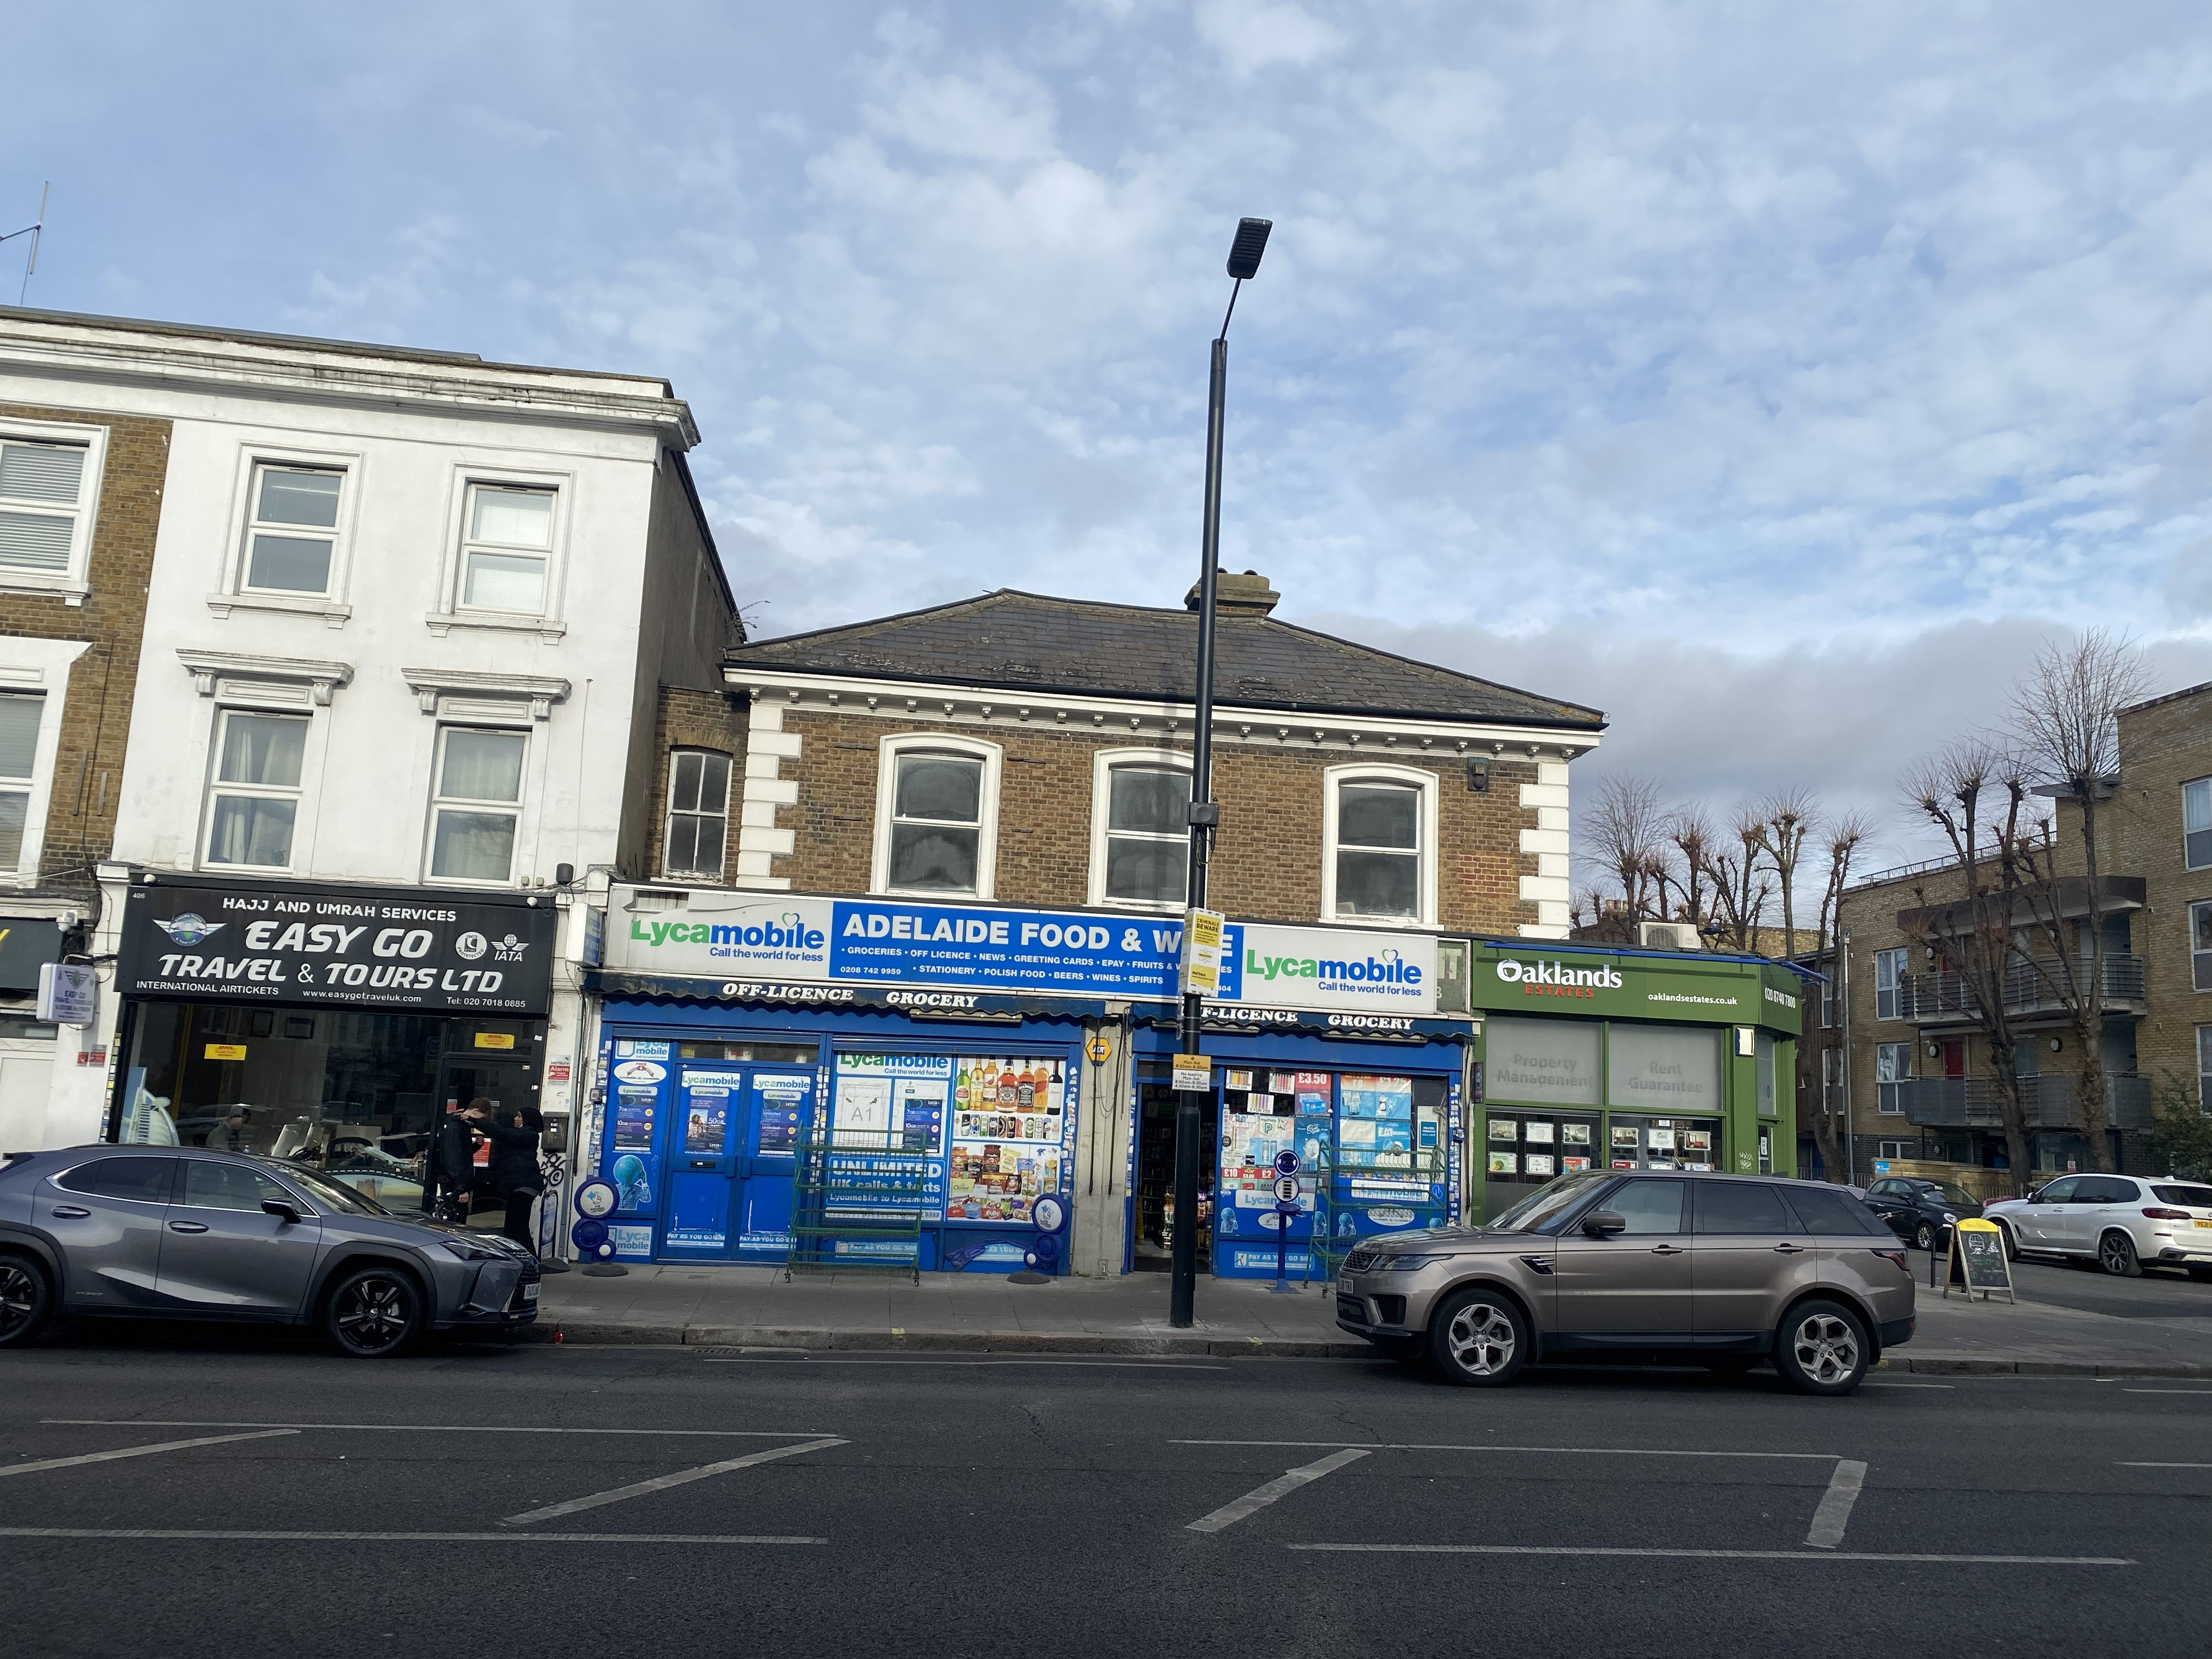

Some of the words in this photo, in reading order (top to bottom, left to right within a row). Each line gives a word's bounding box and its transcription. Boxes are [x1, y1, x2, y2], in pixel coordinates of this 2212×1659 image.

[223, 898, 269, 911] HAJJ
[274, 901, 311, 913] AND
[315, 902, 375, 917] UMRAH
[381, 907, 456, 922] SERVICES
[1197, 918, 1219, 927] CRIMINALS
[1197, 923, 1218, 933] BEWARE
[245, 921, 368, 954] EASY
[372, 928, 433, 958] GO
[631, 919, 825, 949] Lycamobile
[843, 913, 1009, 945] ADELAIDE
[1021, 922, 1110, 950] FOOD
[1121, 928, 1143, 952] &
[494, 951, 522, 962] IATA
[710, 947, 731, 957] Call
[733, 949, 751, 958] the
[753, 950, 783, 960] world
[785, 951, 801, 961] for
[802, 952, 823, 962] less
[848, 946, 902, 956] GROCERIES
[911, 949, 928, 957] OFF
[930, 950, 970, 960] LICENCE
[1014, 955, 1060, 964] GREETING
[1063, 957, 1094, 966] CARDS
[1132, 961, 1164, 970] FRUITS
[158, 953, 287, 982] TRAVEL
[297, 963, 314, 984] &
[324, 962, 438, 989] TOURS
[441, 969, 503, 992] LTD
[1246, 949, 1422, 984] Lycamobile
[1497, 958, 1622, 988] Oaklands
[919, 966, 976, 975] STATIONERY
[984, 968, 1017, 977] POLISH
[1020, 969, 1046, 978] FOOD
[1053, 972, 1084, 980] BEERS
[1092, 973, 1121, 982] WINES
[1128, 975, 1164, 984] SPIRITS
[136, 980, 217, 992] INTERNATIONAL
[219, 984, 279, 995] AIRTICKETS
[1318, 981, 1338, 991] Call
[1339, 983, 1356, 992] the
[1357, 984, 1385, 994] world
[1386, 985, 1401, 995] for
[1402, 986, 1421, 996] less
[1525, 985, 1594, 998] ESTATES
[302, 990, 421, 1002] www.easygotraveluk.com
[446, 997, 462, 1005] Tel:
[464, 997, 480, 1006] 020
[482, 998, 503, 1007] 7018
[505, 1000, 526, 1008] 0885
[723, 983, 854, 1002] OFF-LICENCE
[886, 991, 979, 1008] GROCERY
[1648, 993, 1738, 1005] oaklandsestates.co.uk
[1764, 987, 1773, 1001] 020
[1773, 990, 1784, 1005] 8740
[1785, 994, 1796, 1009] 7800
[1328, 1014, 1414, 1030] GROCERY
[840, 1054, 948, 1068] Lycamobile
[1514, 1053, 1577, 1072] Property
[1650, 1061, 1682, 1075] Rent
[682, 1075, 740, 1085] Lycamobile
[753, 1079, 810, 1088] Lycamobile
[1298, 1073, 1327, 1085] £3.50
[1498, 1069, 1593, 1087] Management
[1628, 1077, 1703, 1093] Guarantee
[851, 1107, 872, 1121] A1
[1378, 1127, 1393, 1137] EAT
[833, 1160, 942, 1178] UNLIMITED
[1224, 1169, 1238, 1177] £10
[1262, 1170, 1272, 1178] £2
[831, 1179, 851, 1188] UK
[618, 1229, 650, 1243] Lyca
[617, 1242, 649, 1250] mobile
